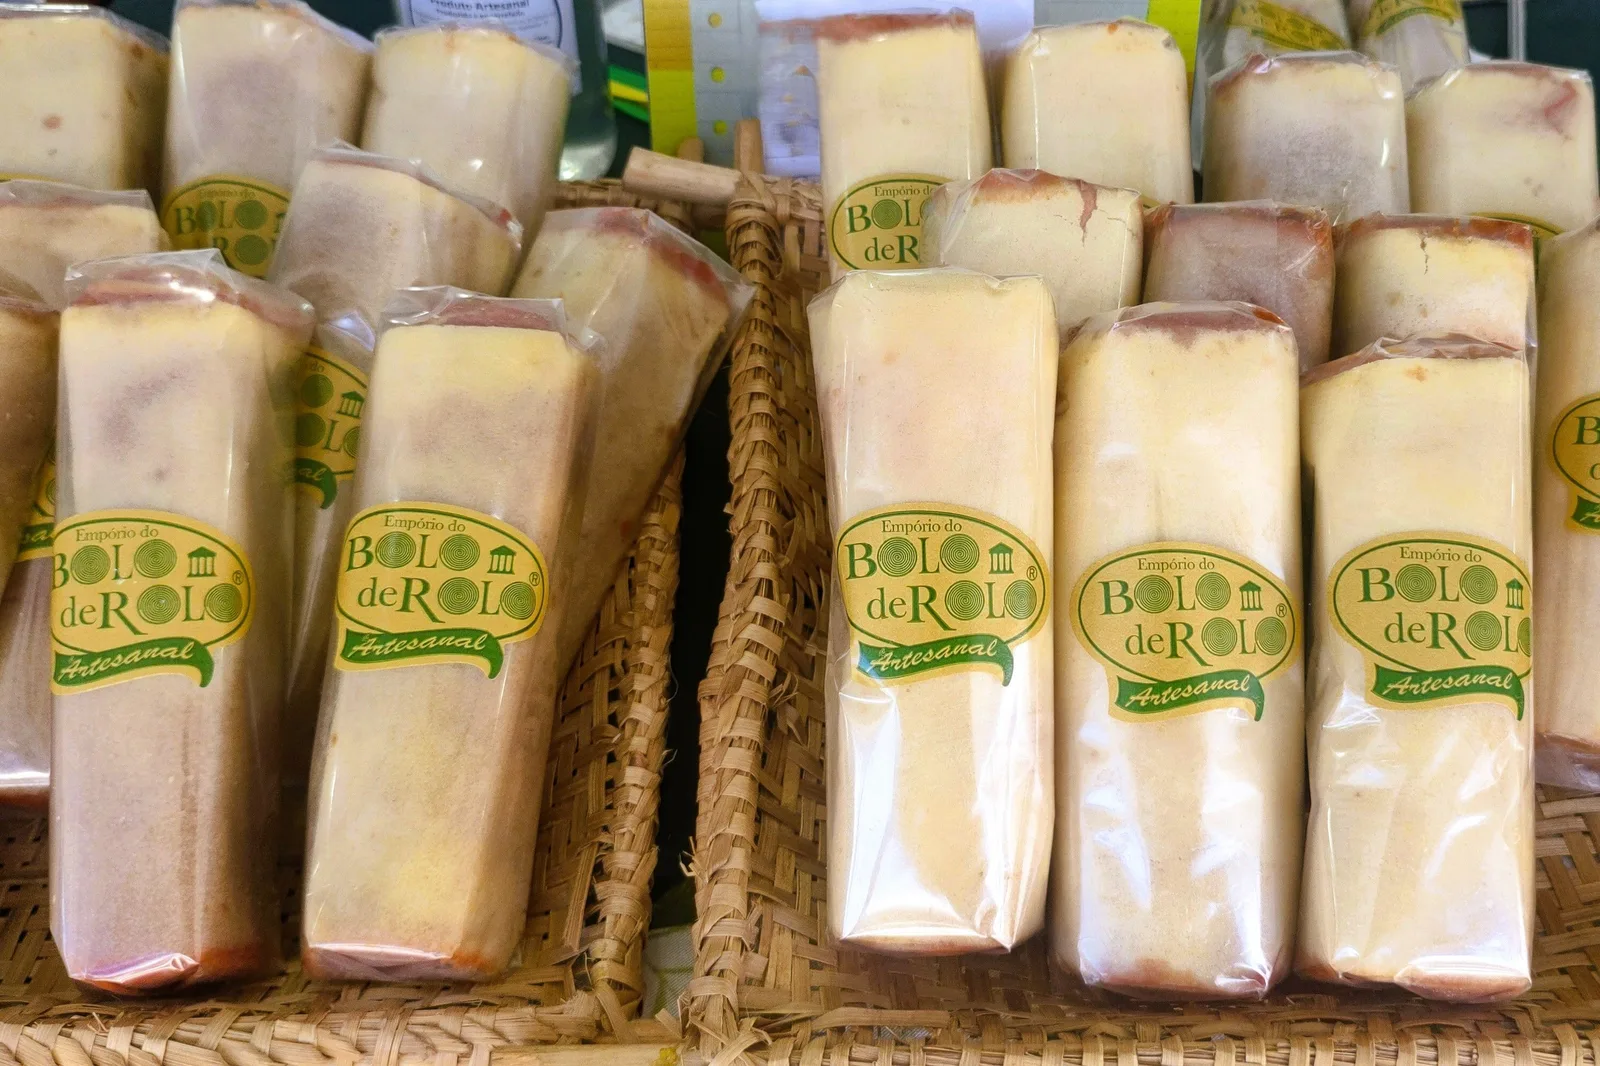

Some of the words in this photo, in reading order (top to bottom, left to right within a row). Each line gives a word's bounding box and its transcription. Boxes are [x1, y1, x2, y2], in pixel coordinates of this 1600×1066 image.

[76, 526, 136, 543] Empório
[140, 525, 159, 538] do
[383, 515, 444, 531] Empório
[448, 521, 466, 532] do
[881, 518, 940, 535] Empório
[944, 519, 962, 532] do
[346, 531, 481, 572] BOLO
[845, 533, 980, 580] BOLO
[1137, 557, 1195, 573] Empório
[1199, 558, 1215, 570] do
[1400, 546, 1460, 562] Empório
[1464, 550, 1482, 562] do
[1098, 572, 1231, 615] BOLO
[1356, 563, 1498, 604] BOLO
[348, 634, 488, 657] Artesanal
[867, 639, 998, 671] Artesanal
[58, 642, 194, 681] Artesanal
[1125, 674, 1250, 707] Artesanal
[1383, 672, 1514, 695] Artesanal
